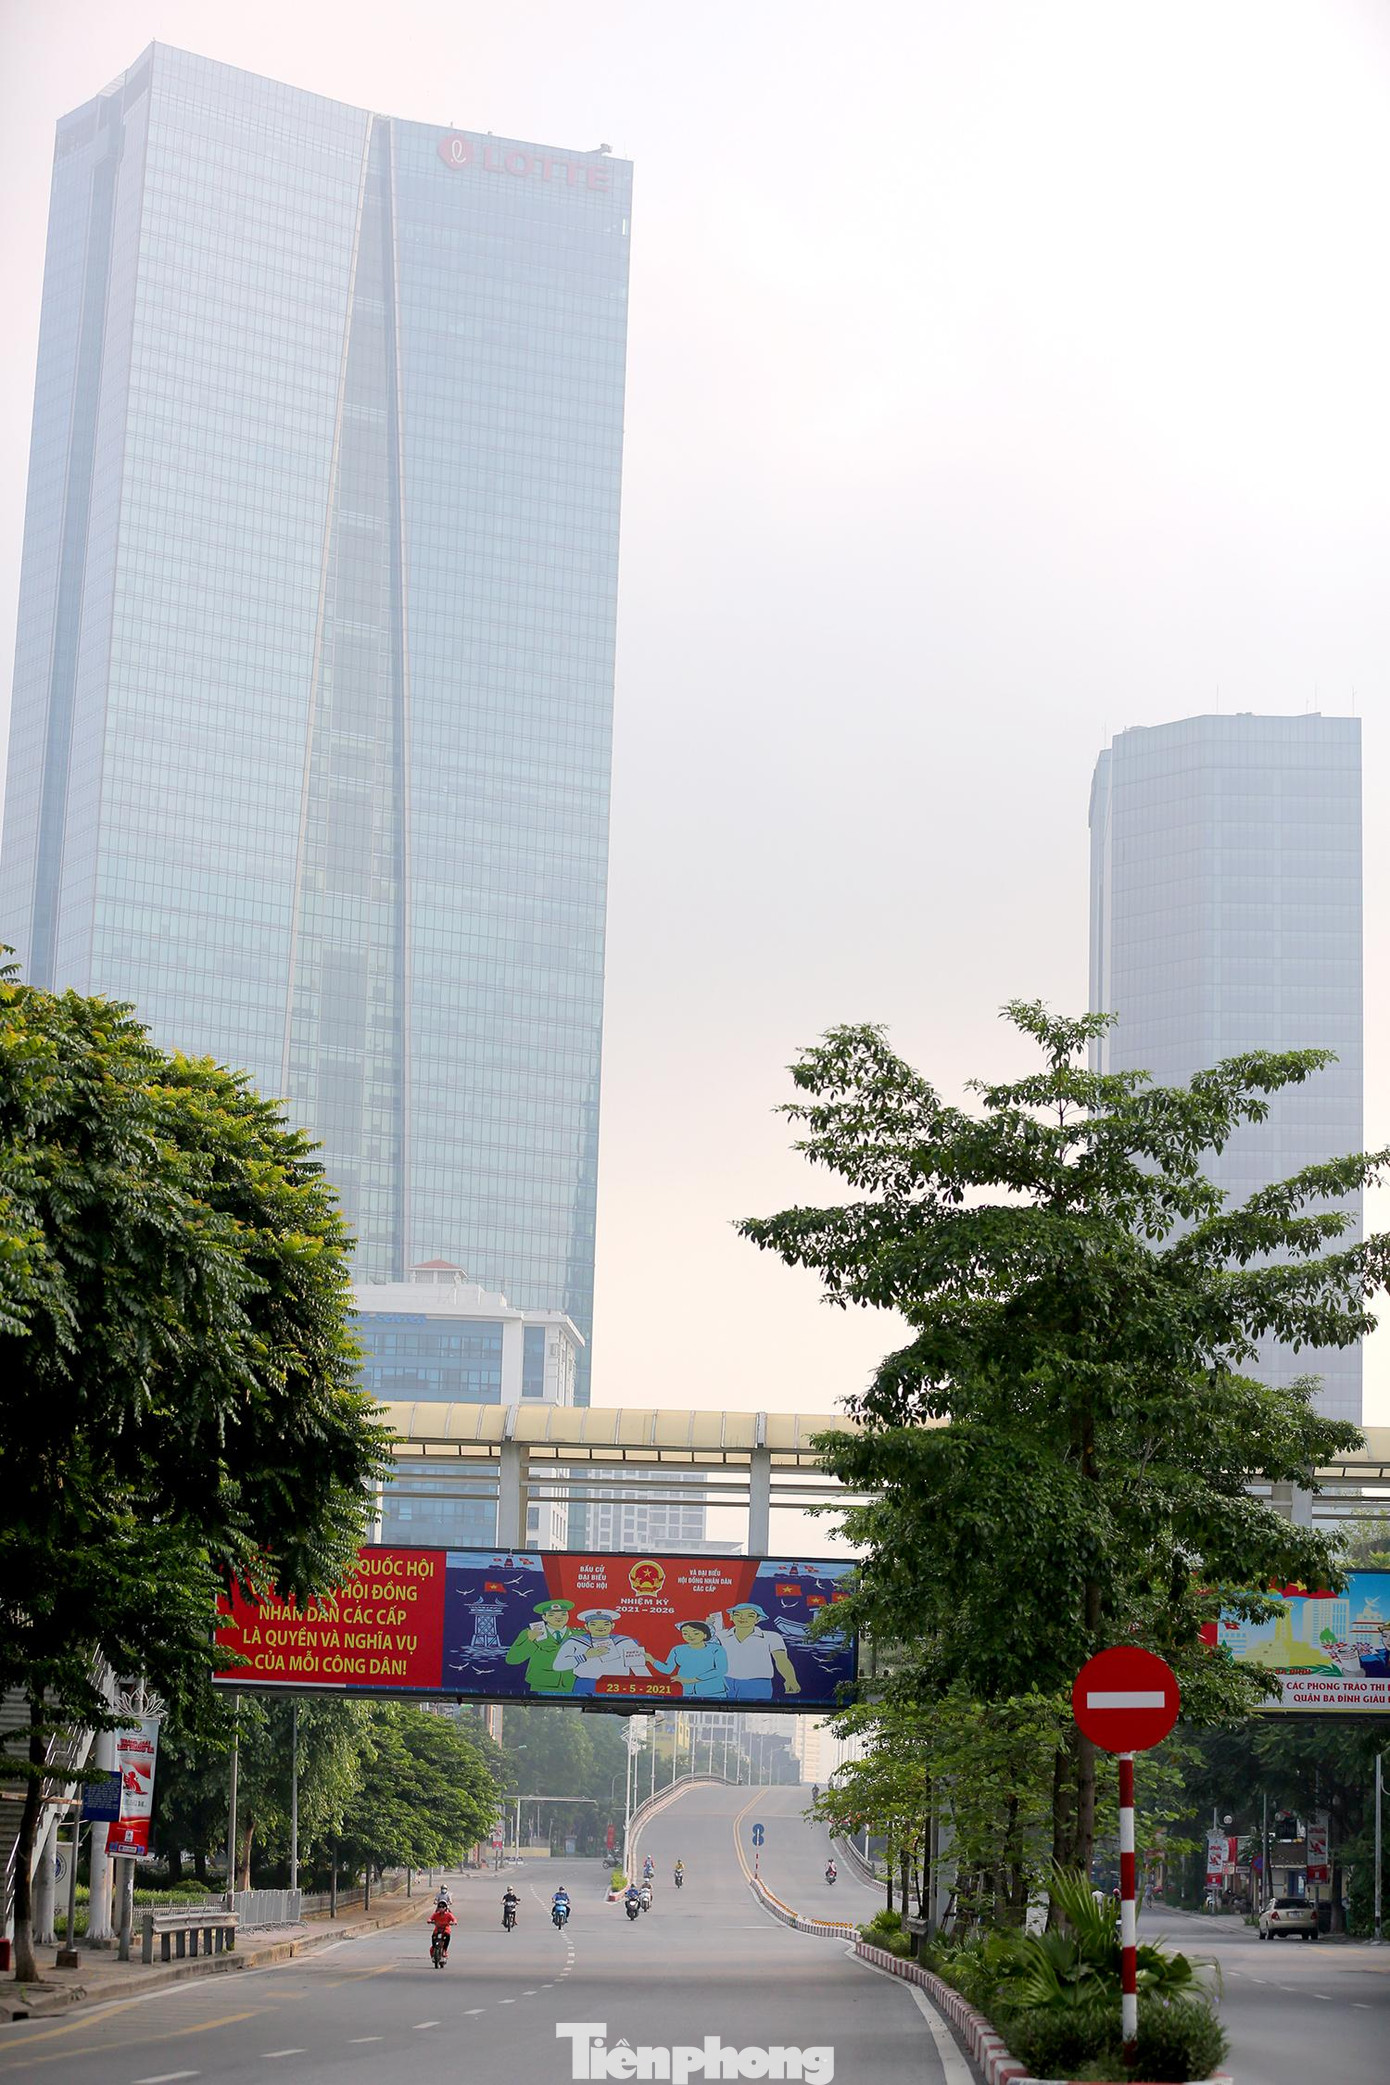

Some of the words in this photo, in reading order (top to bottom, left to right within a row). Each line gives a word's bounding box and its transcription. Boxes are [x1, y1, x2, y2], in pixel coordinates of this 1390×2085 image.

[484, 146, 609, 193] LOTTE
[360, 1556, 403, 1576] QUỐC
[407, 1558, 434, 1580] HỘI
[342, 1581, 368, 1602] HỘI
[371, 1581, 418, 1602] ĐỒNG
[620, 1597, 653, 1606] NHIỆM
[343, 1606, 373, 1625] CÁC
[376, 1605, 407, 1626] CẤP
[243, 1626, 262, 1645] LÀ
[265, 1626, 317, 1647] QUYỀN
[320, 1629, 340, 1648] VÀ
[344, 1631, 393, 1650] NGHĨA
[396, 1634, 418, 1655] VỤ
[254, 1650, 285, 1671] CỦA
[289, 1650, 319, 1672] MỖI
[322, 1655, 366, 1674] CÔNG
[369, 1656, 407, 1676] DÂN!
[606, 1683, 620, 1692] 23
[629, 1684, 636, 1692] 5
[646, 1685, 672, 1694] 2021
[1286, 1681, 1304, 1690] CÁC
[1307, 1682, 1340, 1690] PHONG
[1370, 1683, 1385, 1691] THI
[1293, 1693, 1320, 1704] QUẬN
[1323, 1694, 1336, 1703] BA
[1337, 1693, 1361, 1703] ĐÌNH
[1362, 1694, 1385, 1703] GIÀU
